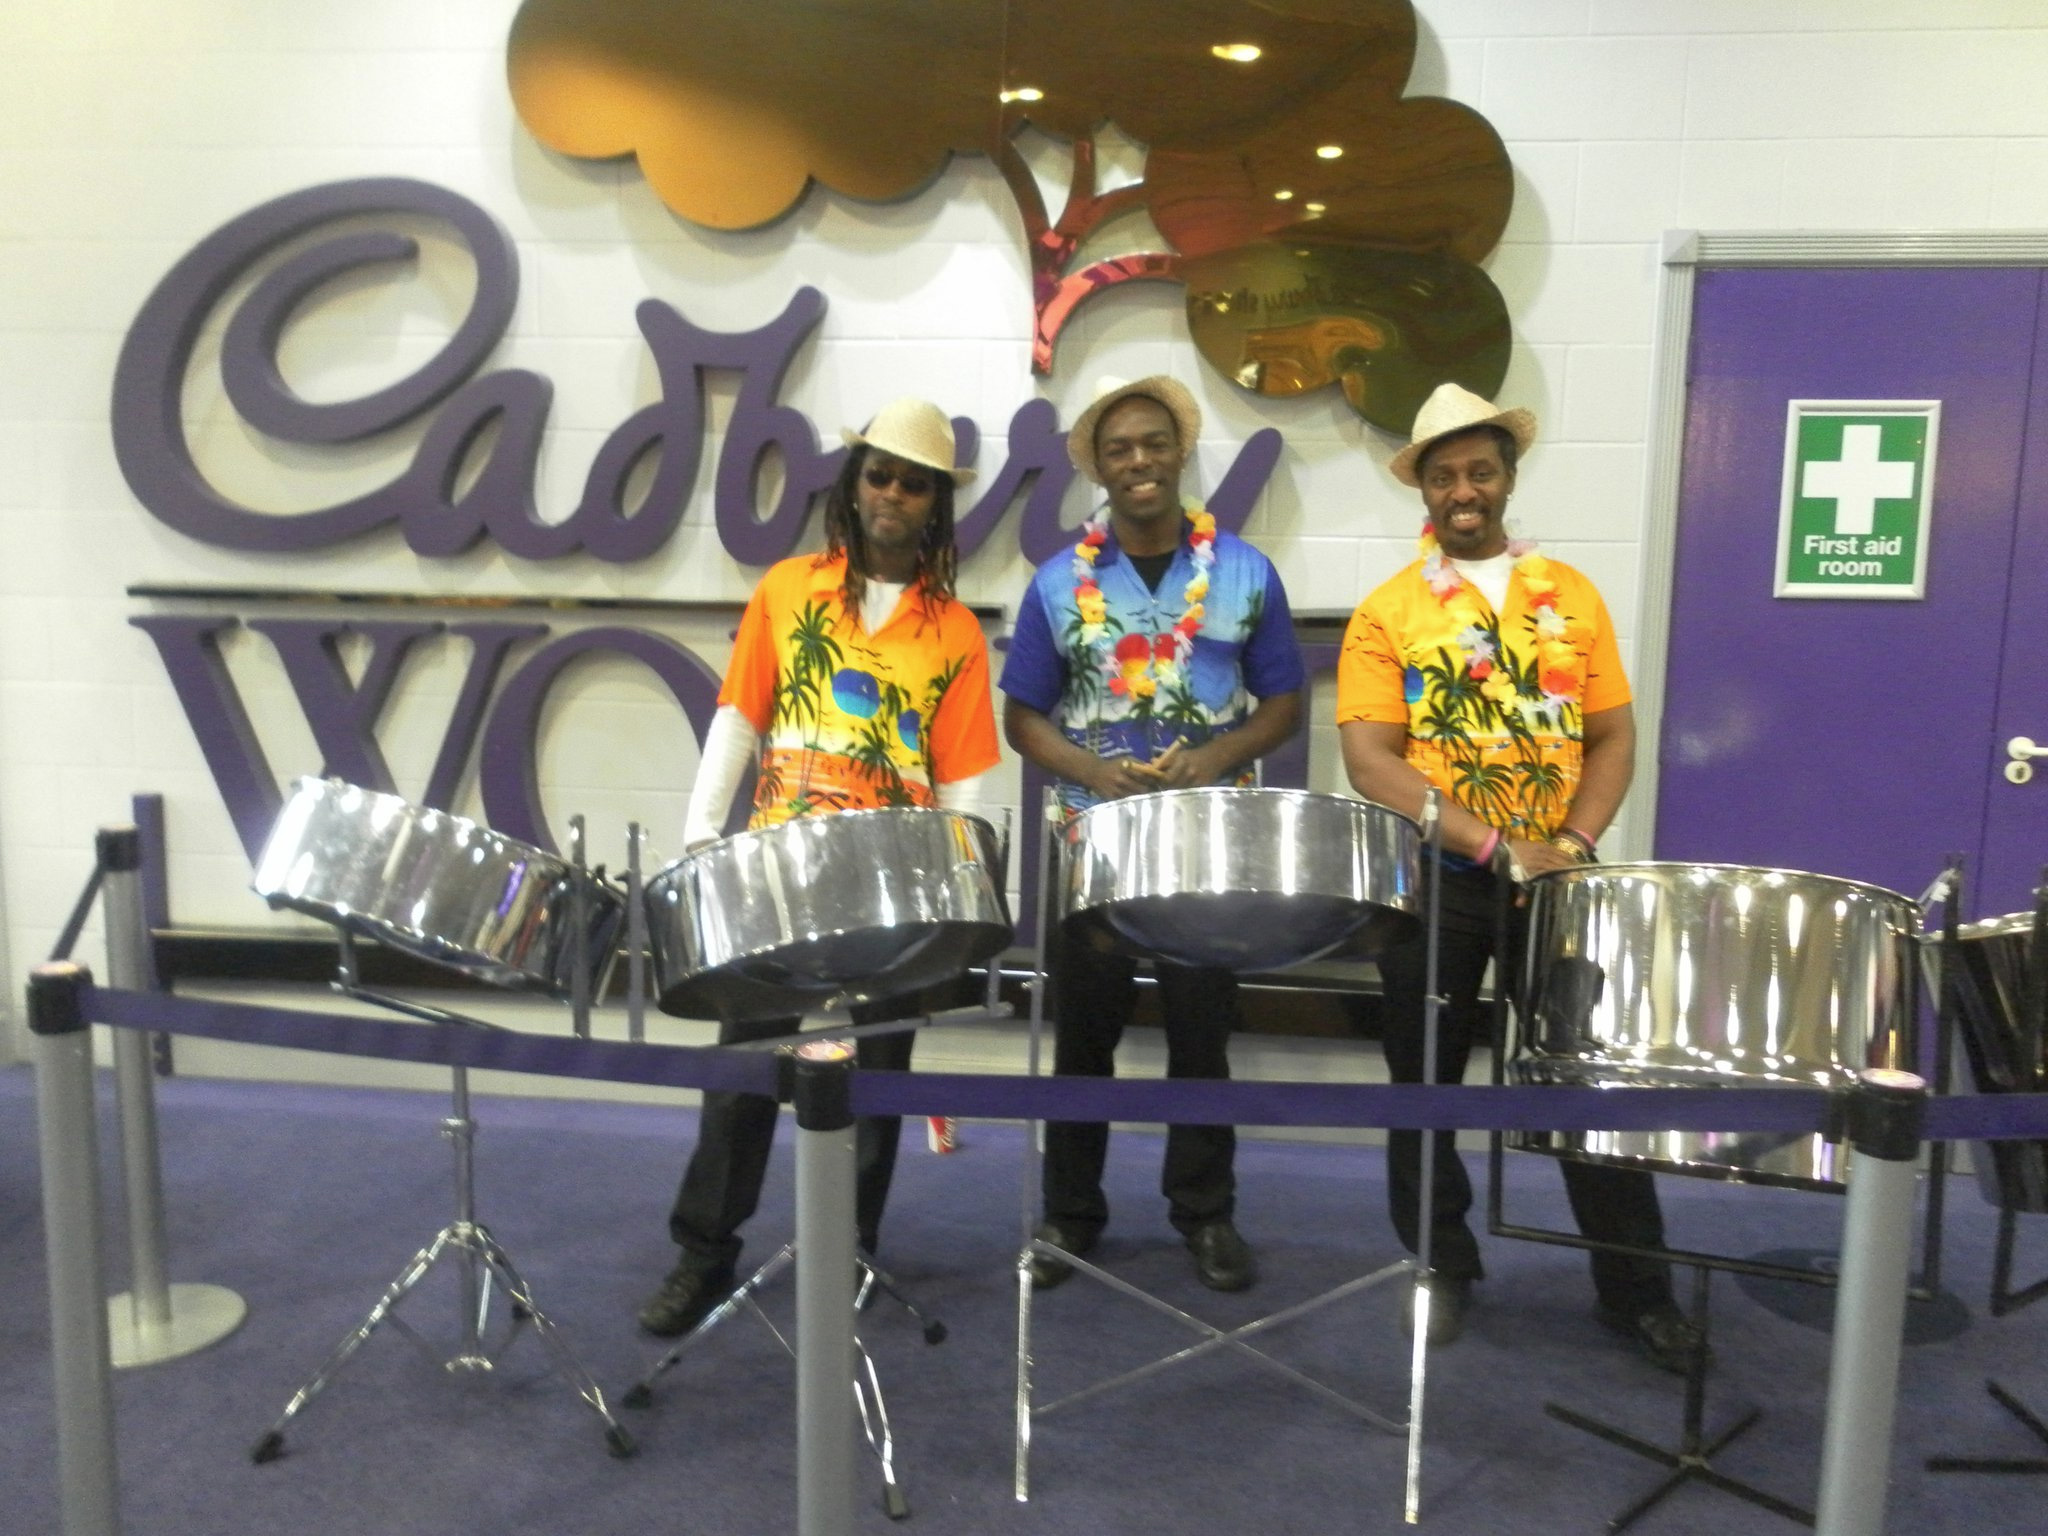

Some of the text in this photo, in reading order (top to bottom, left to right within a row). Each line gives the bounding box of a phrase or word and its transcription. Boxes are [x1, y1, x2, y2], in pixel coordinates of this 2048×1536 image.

[1803, 535, 1902, 556] First aid
[1818, 561, 1882, 576] room
